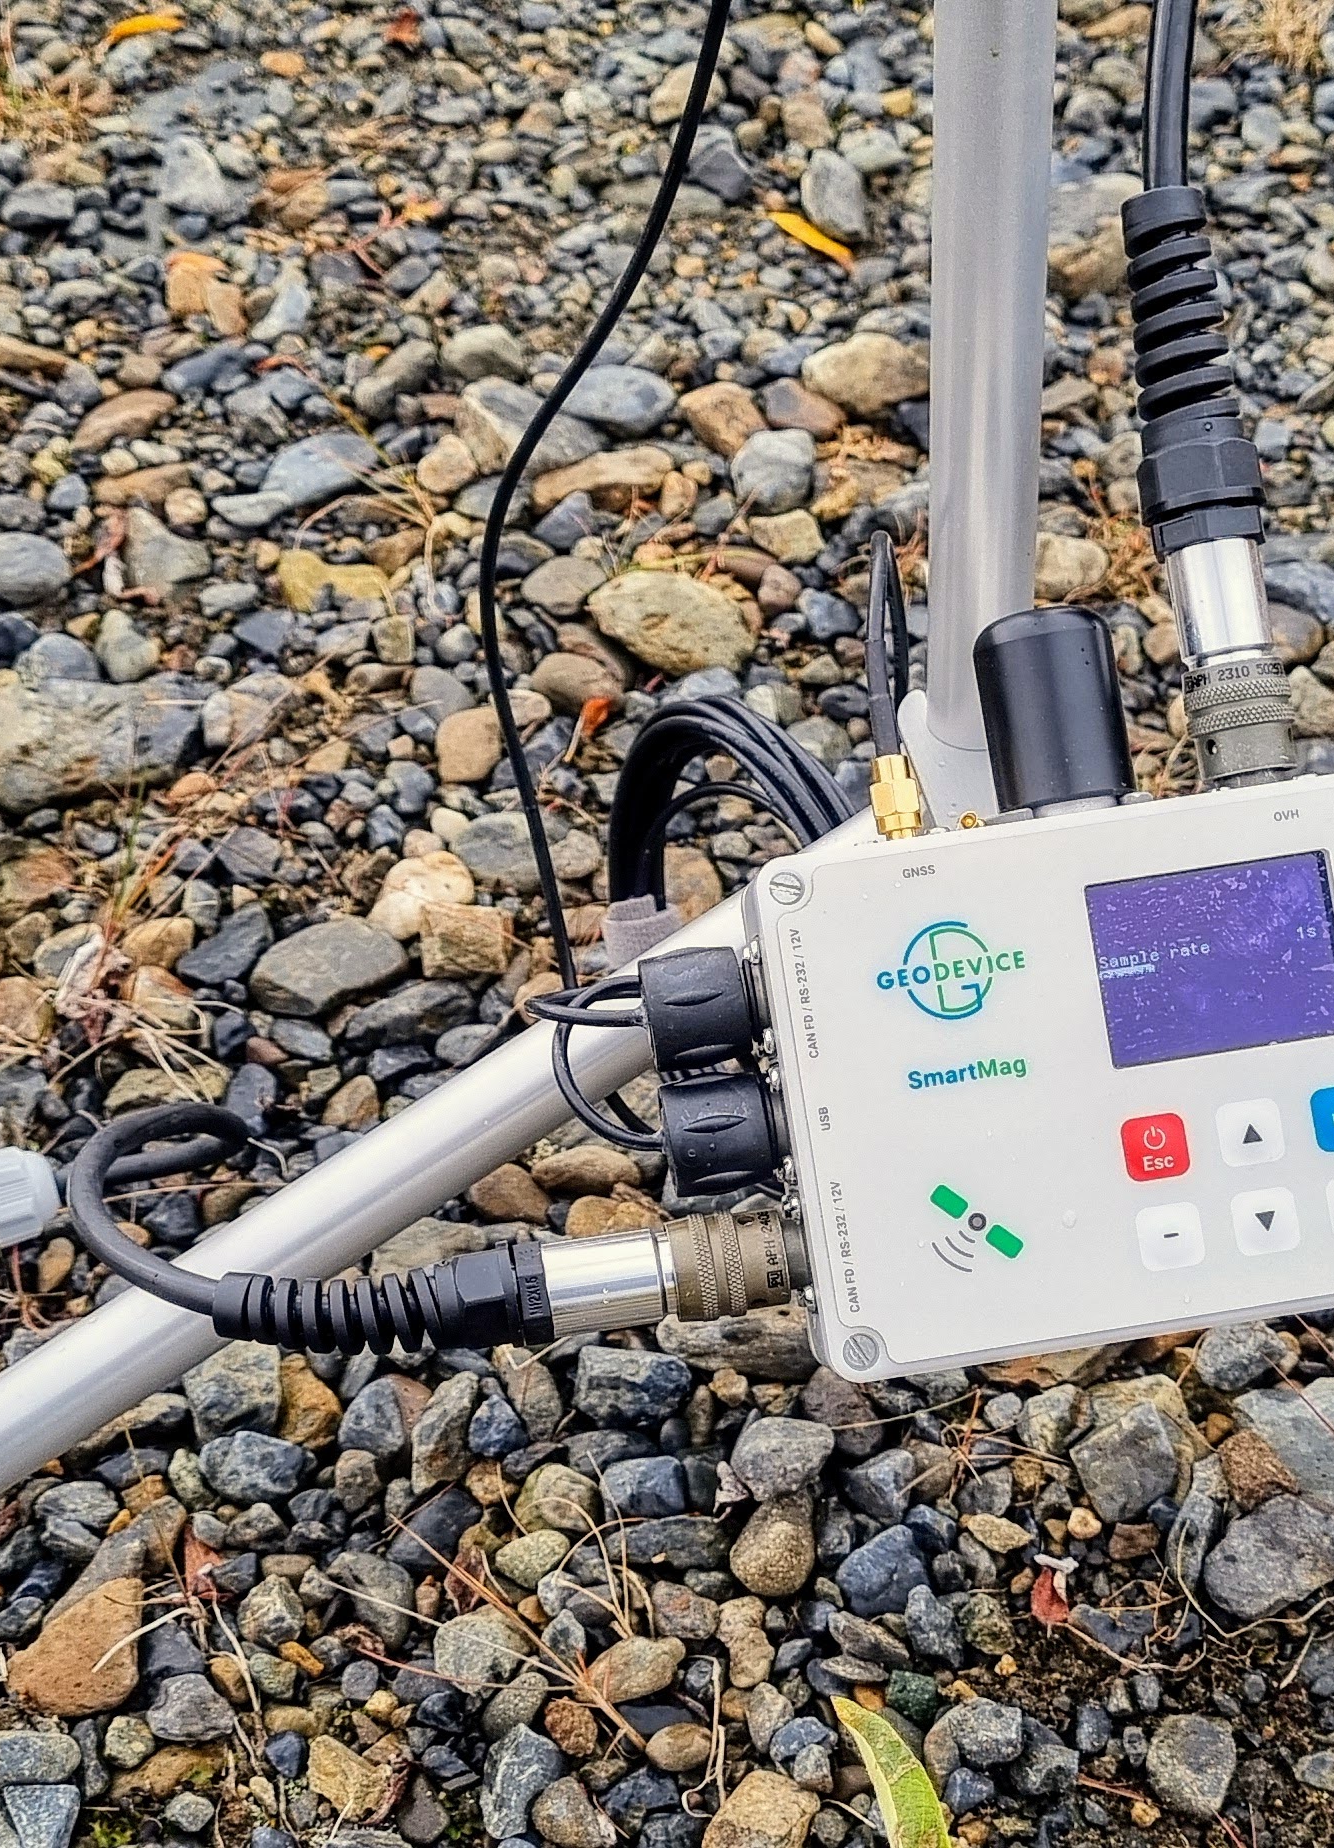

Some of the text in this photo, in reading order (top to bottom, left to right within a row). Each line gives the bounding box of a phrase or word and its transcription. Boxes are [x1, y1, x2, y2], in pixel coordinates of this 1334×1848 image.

[1218, 665, 1250, 681] 2310
[1273, 809, 1299, 821] OVH
[902, 864, 936, 878] GNSS
[789, 928, 802, 951] 12V
[1099, 943, 1211, 970] Sample rate
[876, 950, 1026, 990] GEODEVICE
[794, 961, 811, 1005] RS-232
[803, 1014, 816, 1031] FD
[806, 1033, 819, 1059] CAN
[907, 1059, 1027, 1090] SmartMag
[818, 1106, 831, 1131] USB
[1143, 1154, 1175, 1171] Esc
[829, 1181, 843, 1204] 12V
[834, 1214, 852, 1259] RS-232
[844, 1269, 856, 1286] FD
[846, 1287, 860, 1313] CAN
